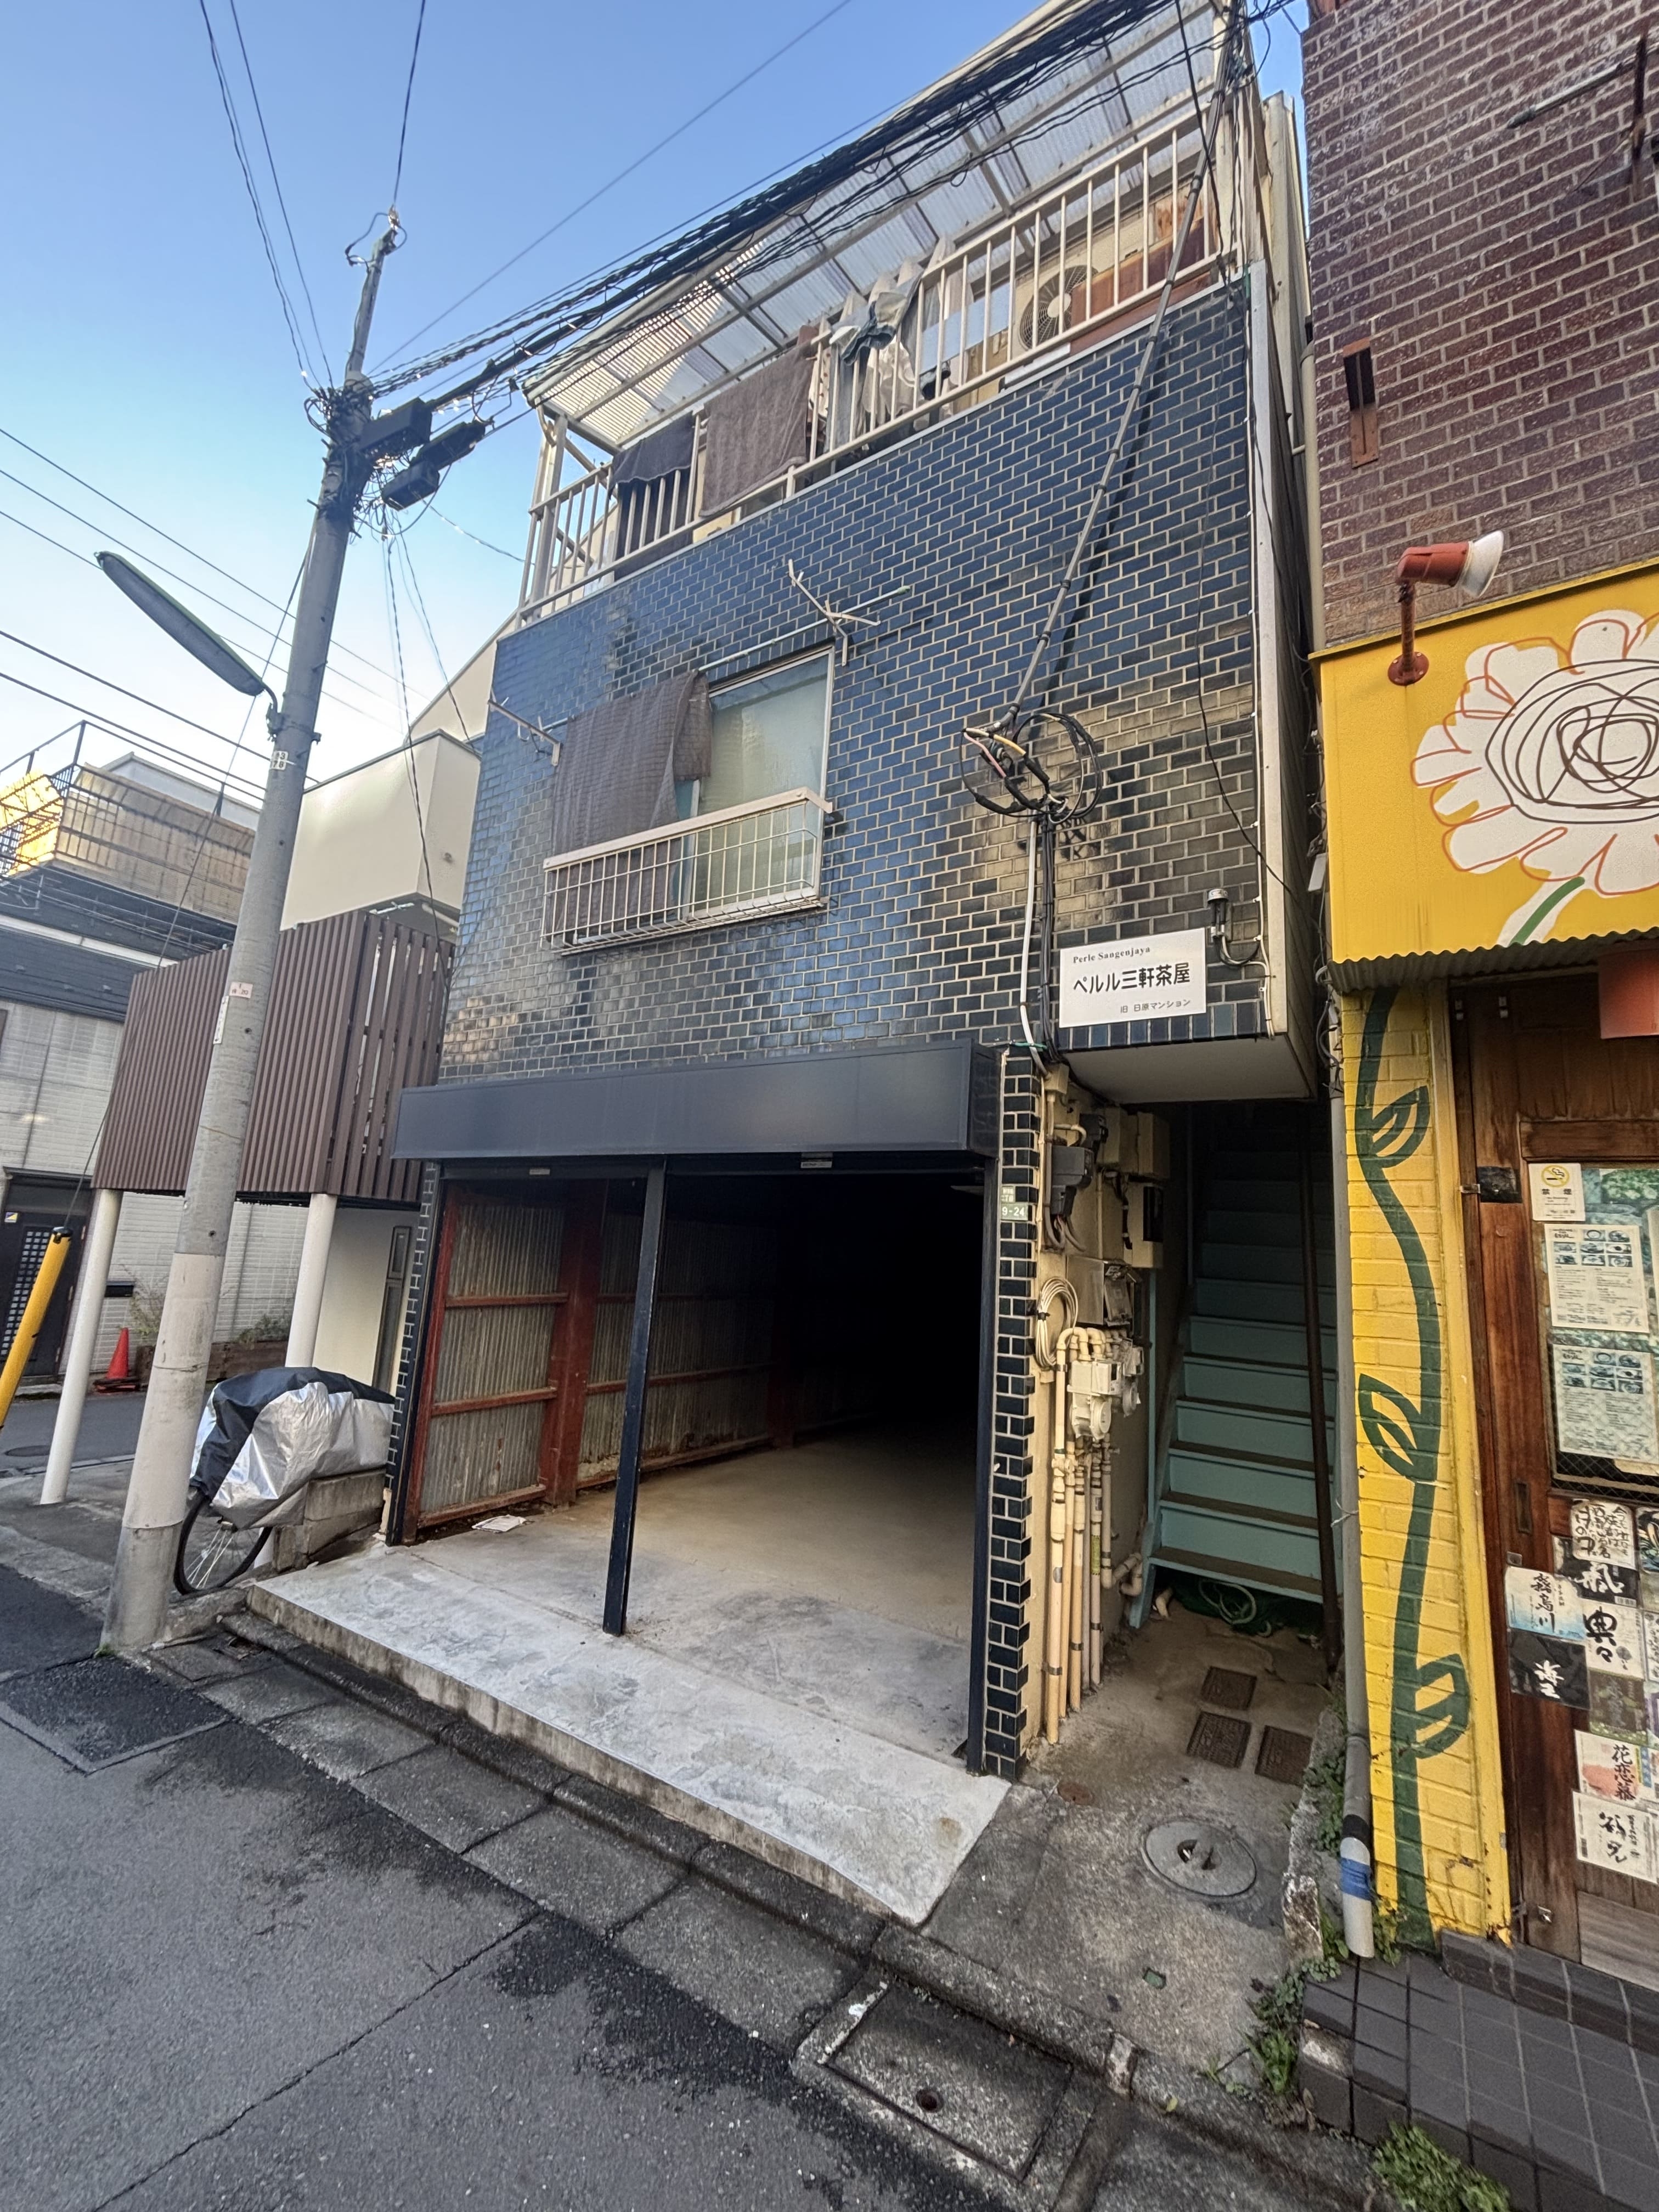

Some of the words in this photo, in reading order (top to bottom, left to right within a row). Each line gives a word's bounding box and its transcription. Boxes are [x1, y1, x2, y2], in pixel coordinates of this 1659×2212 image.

[1073, 954, 1096, 964] Perle
[1098, 946, 1150, 961] Sangenjaya
[1073, 962, 1190, 994] ペルル三軒茶屋
[1120, 1005, 1128, 1014] 旧
[1002, 1206, 1025, 1216] 9-24
